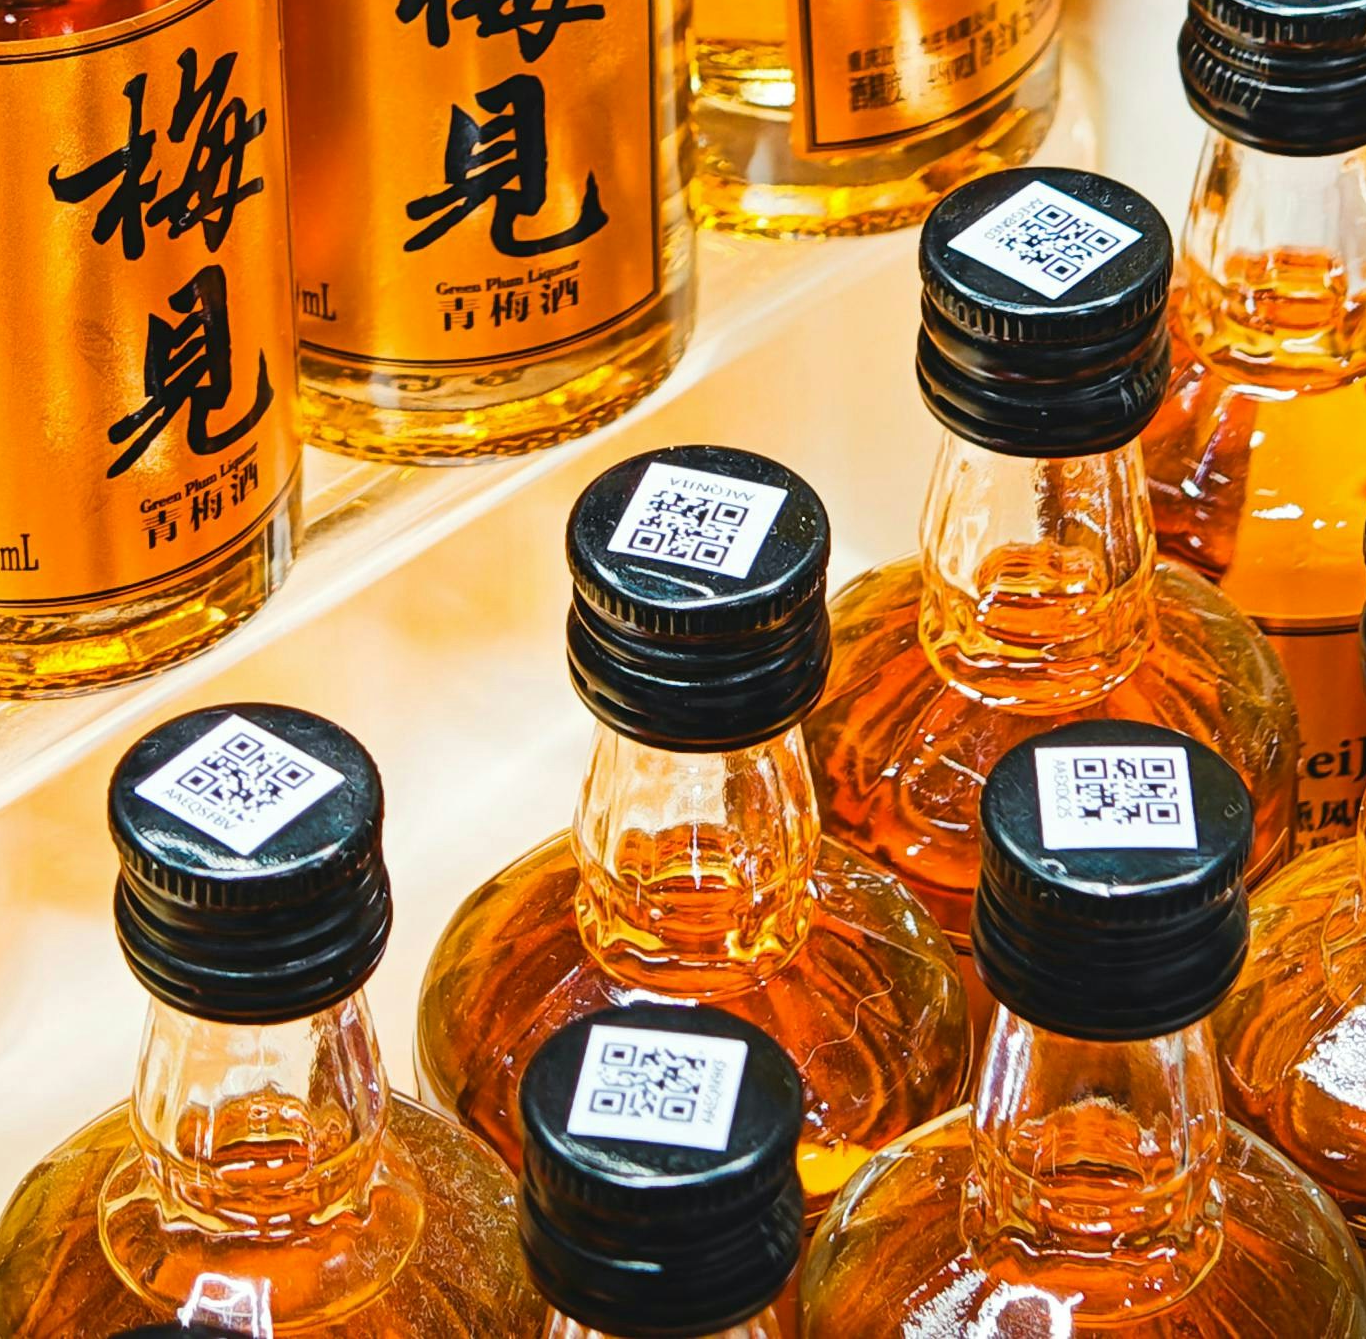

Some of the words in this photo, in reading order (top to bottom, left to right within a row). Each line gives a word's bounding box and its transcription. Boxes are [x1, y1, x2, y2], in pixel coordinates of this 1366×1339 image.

[48, 47, 274, 479] 梅見
[436, 281, 482, 296] Green
[486, 276, 524, 291] Plum
[438, 274, 579, 332] 青梅酒
[140, 457, 259, 550] 青梅酒
